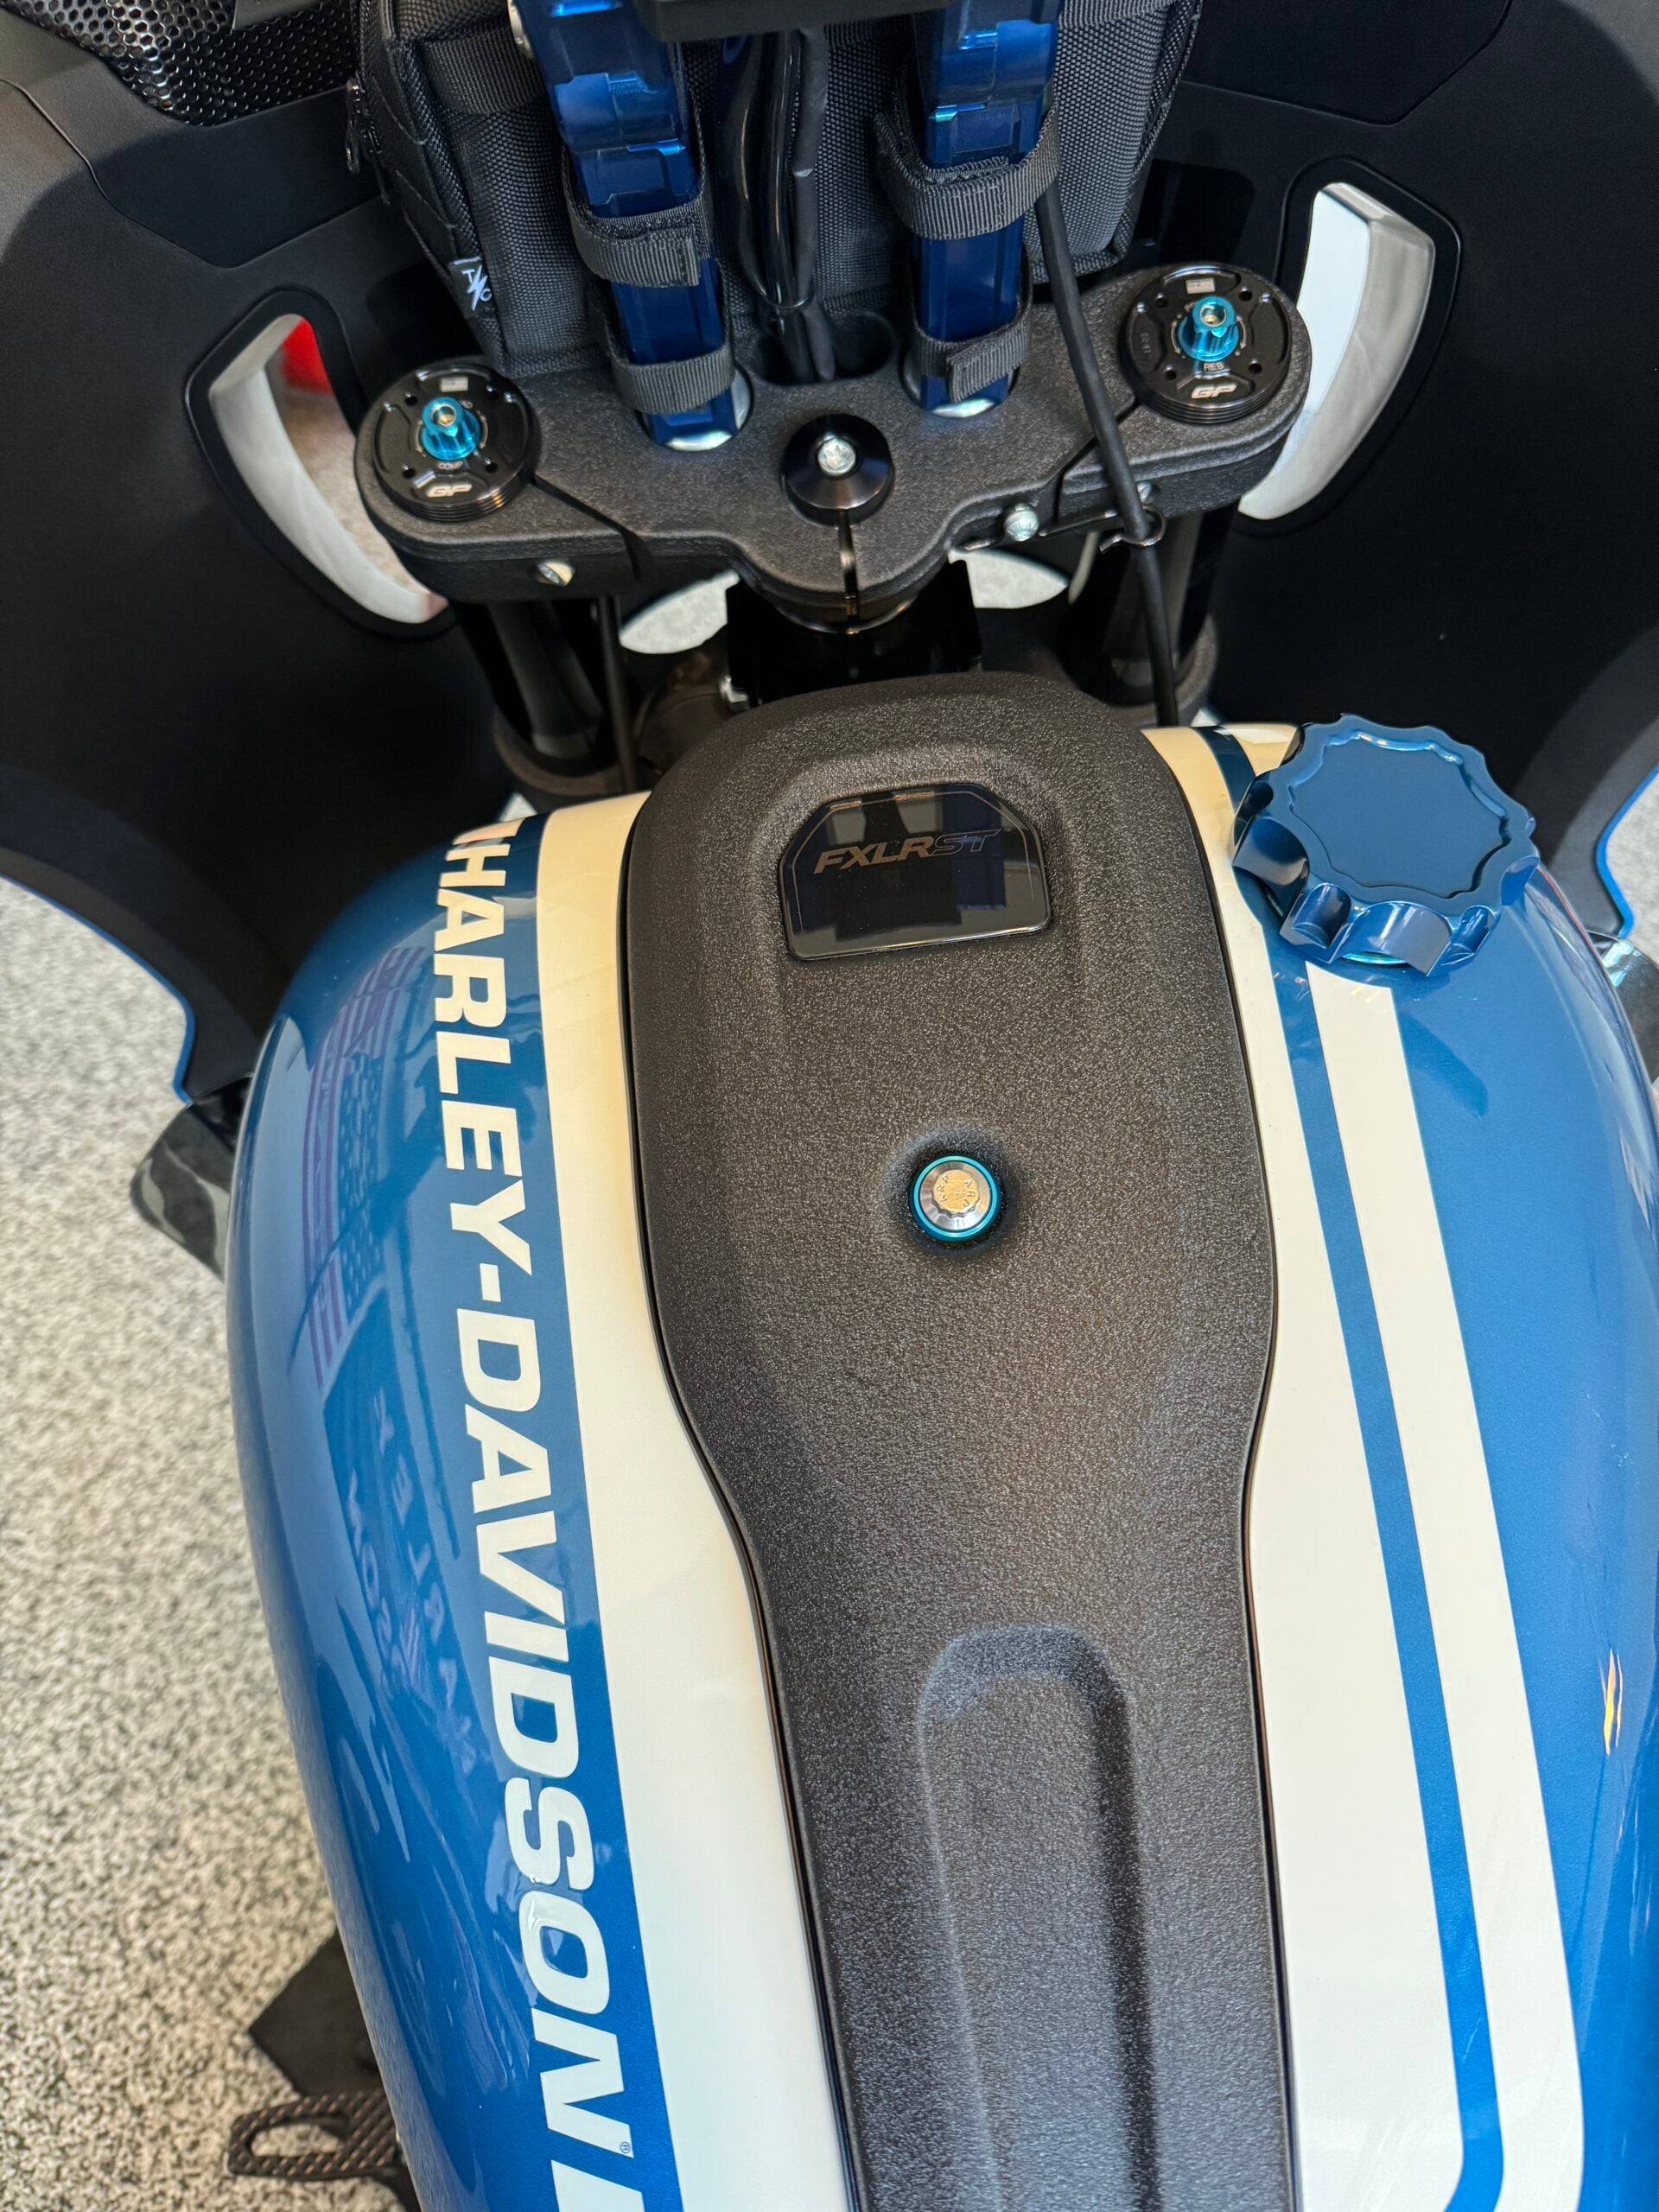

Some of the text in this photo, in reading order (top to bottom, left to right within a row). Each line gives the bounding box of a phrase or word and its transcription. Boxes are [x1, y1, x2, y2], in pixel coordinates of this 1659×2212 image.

[1191, 384, 1237, 399] GP
[426, 483, 473, 499] GP
[813, 828, 1001, 874] FXLRST
[434, 842, 634, 2159] HARLEY-DAVIDSON
